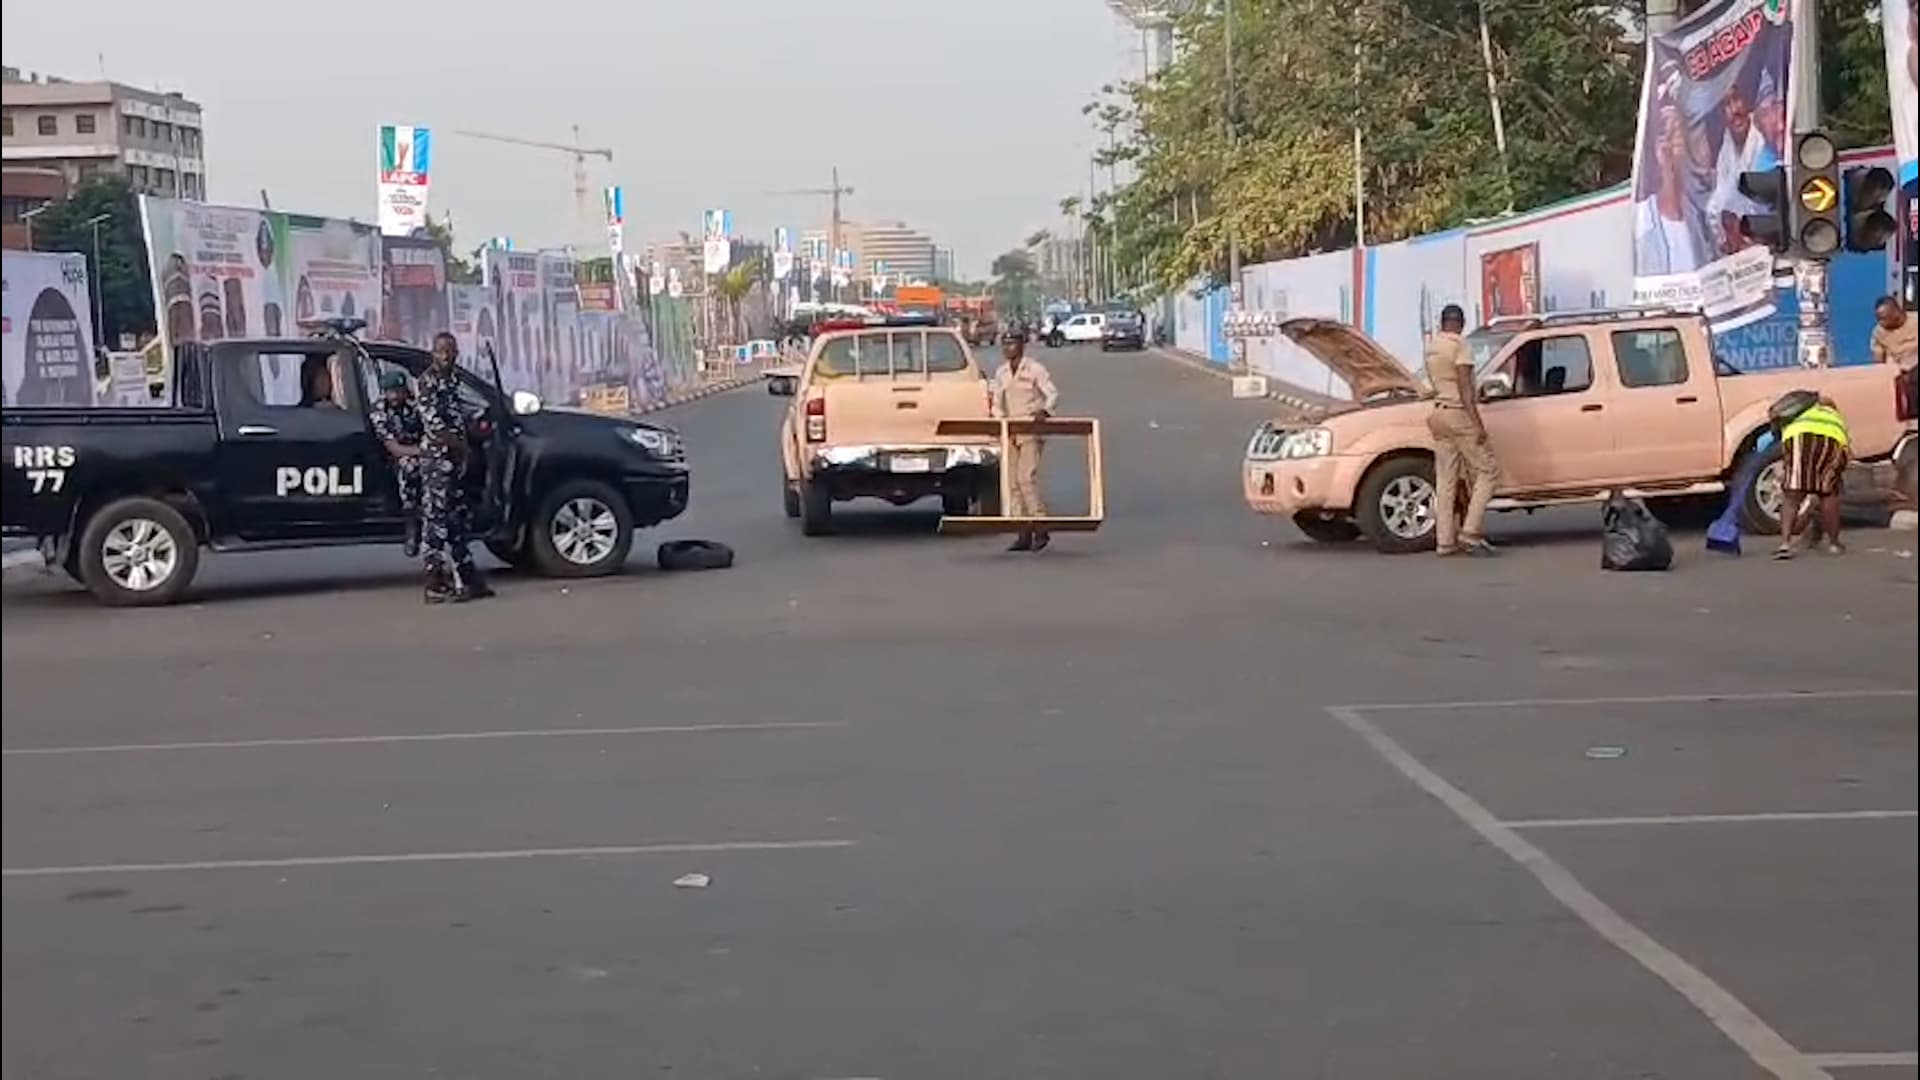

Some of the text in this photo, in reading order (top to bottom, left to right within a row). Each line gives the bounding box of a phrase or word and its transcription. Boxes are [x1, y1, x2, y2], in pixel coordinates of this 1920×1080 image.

[389, 171, 419, 185] APC
[14, 446, 75, 468] RRS
[26, 471, 65, 494] 77
[276, 465, 363, 496] POLI
